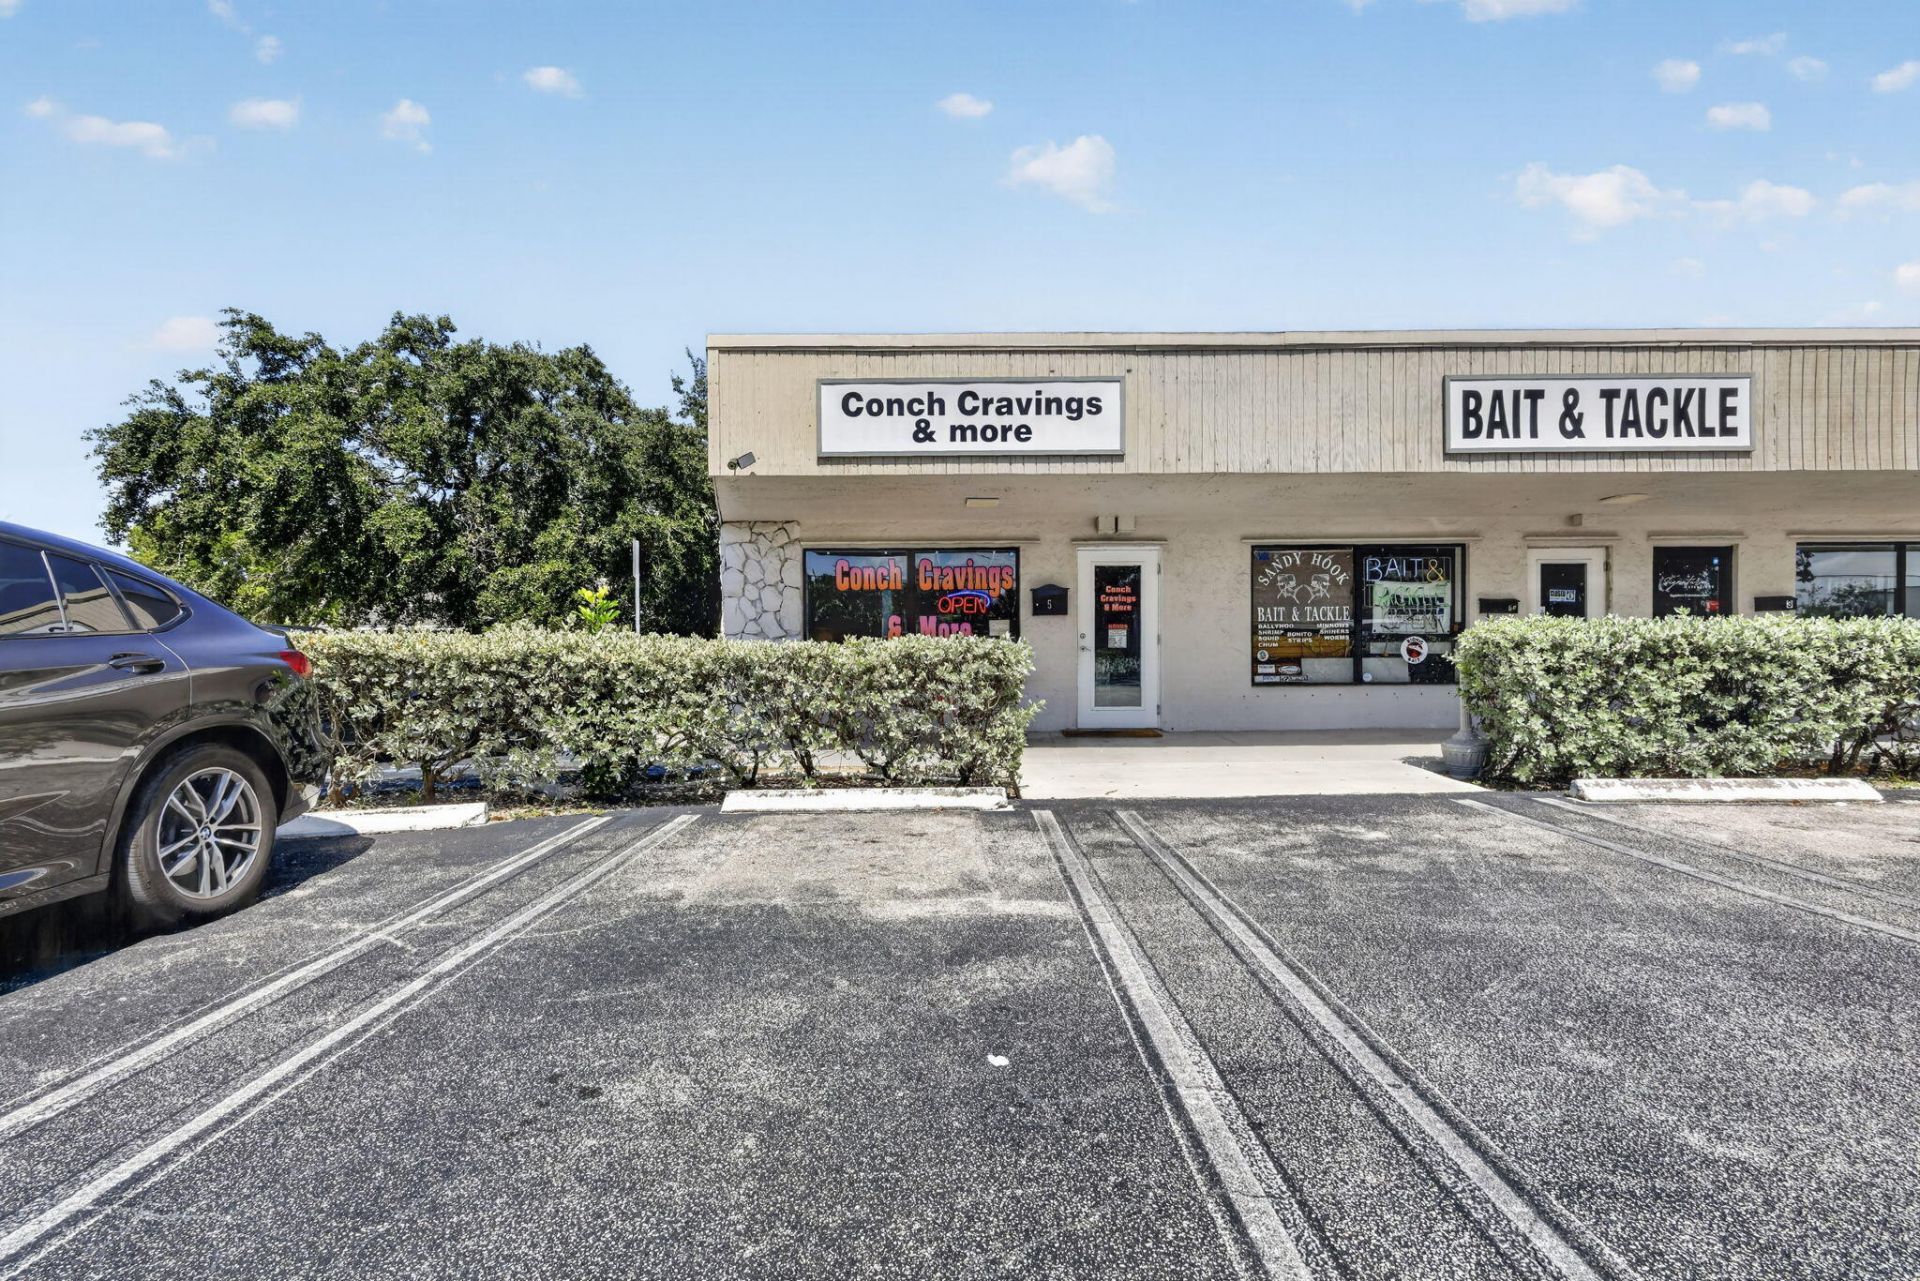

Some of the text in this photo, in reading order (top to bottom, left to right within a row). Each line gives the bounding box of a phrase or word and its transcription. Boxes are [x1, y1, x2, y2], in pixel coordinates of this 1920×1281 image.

[841, 390, 1103, 421] Conch Cravings
[1462, 386, 1739, 440] BAIT & TACKLE
[912, 418, 1033, 443] & more
[835, 558, 1014, 598] Conch Cravings
[1258, 552, 1349, 586] SANDY HOOK
[1366, 557, 1445, 582] BAIT &
[1100, 594, 1137, 604] Cravings
[1105, 585, 1132, 593] Conch
[938, 596, 988, 614] OPEN
[1047, 599, 1052, 610] 5
[1111, 603, 1132, 612] More
[1257, 605, 1351, 622] BAIT & TACKLE
[887, 615, 973, 640] & More
